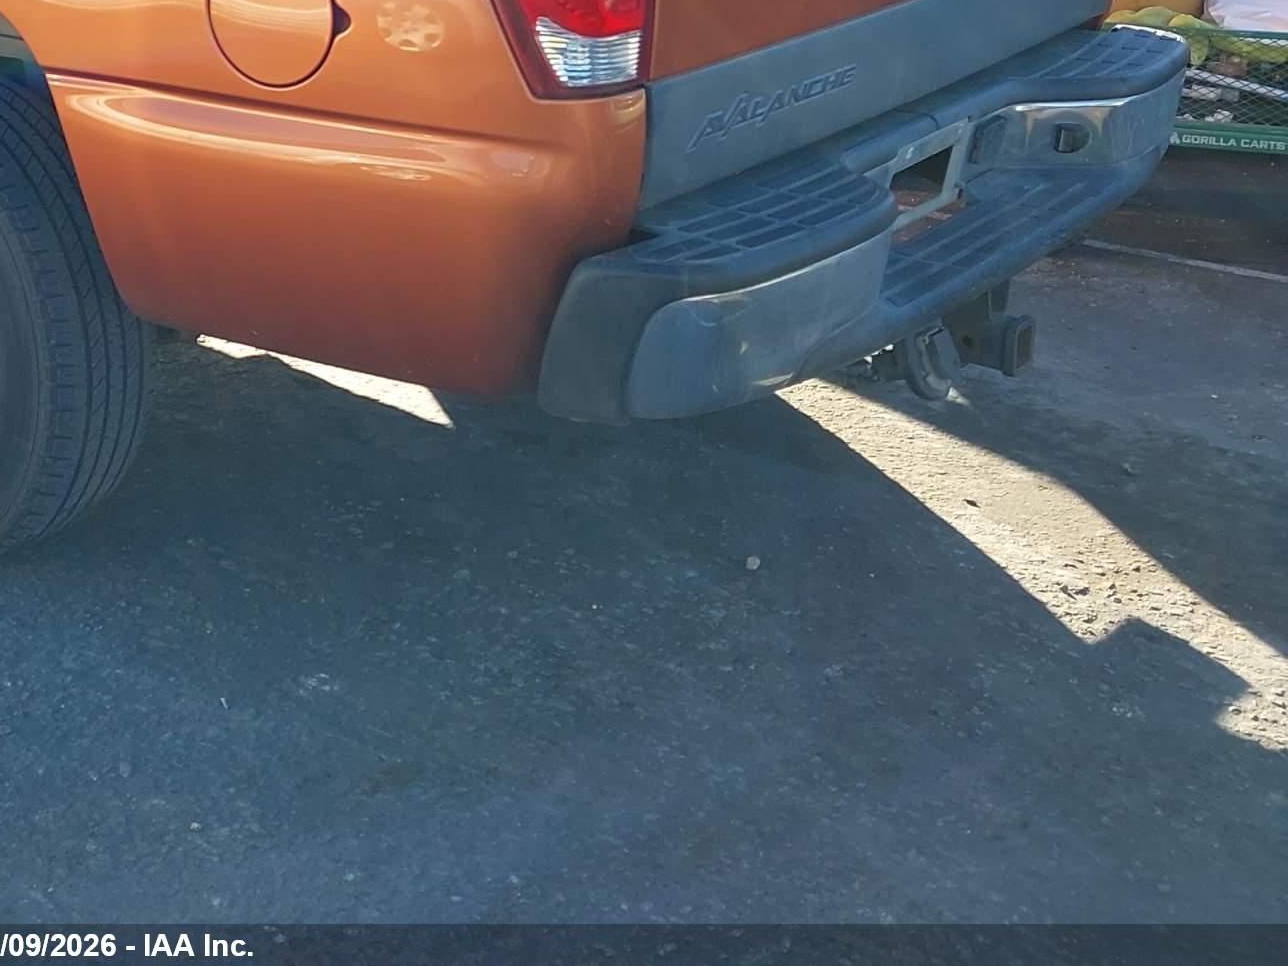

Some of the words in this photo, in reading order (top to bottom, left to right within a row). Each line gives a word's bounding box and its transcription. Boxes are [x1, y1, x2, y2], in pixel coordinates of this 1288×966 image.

[686, 64, 857, 153] AVALANCHE
[1182, 134, 1237, 147] GORILLA
[1240, 139, 1286, 150] CARTS
